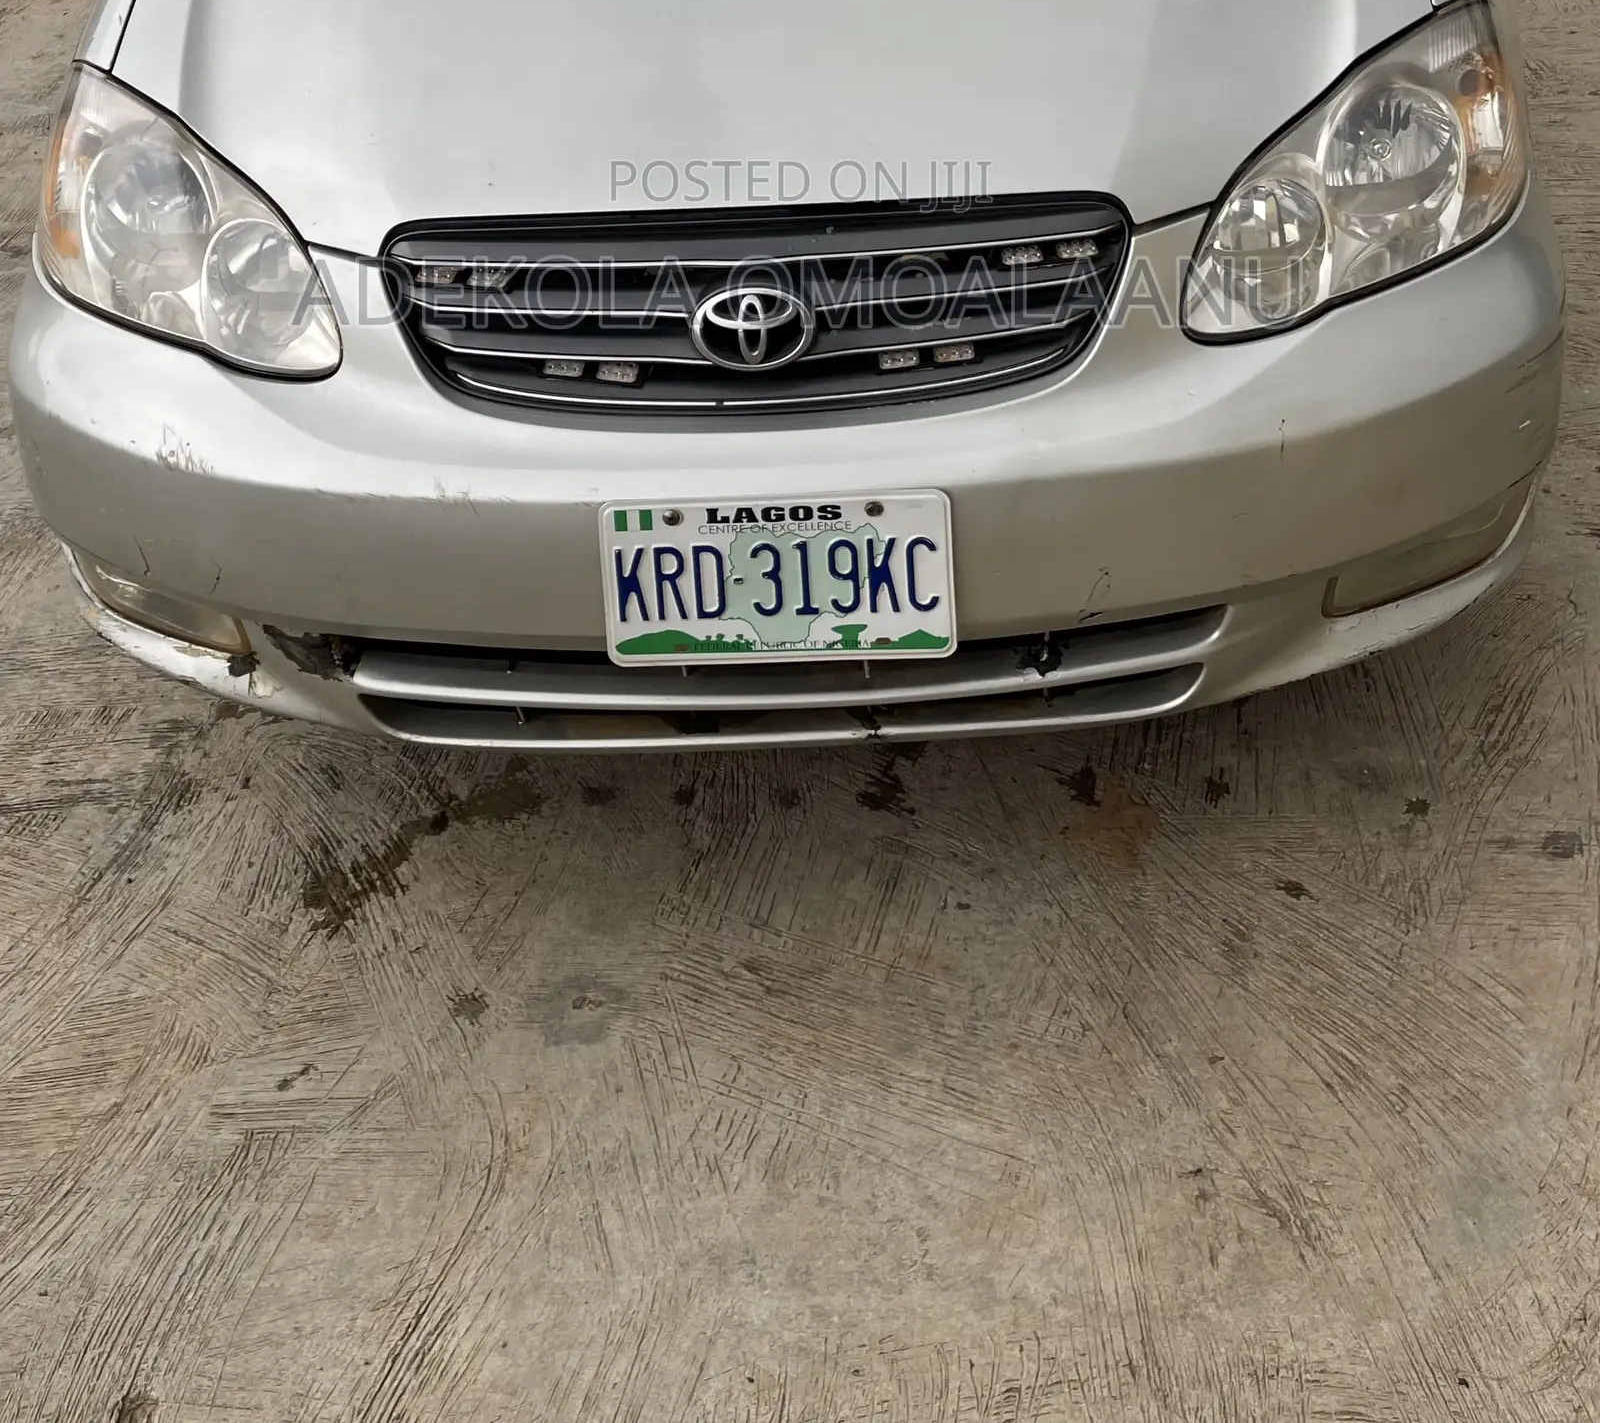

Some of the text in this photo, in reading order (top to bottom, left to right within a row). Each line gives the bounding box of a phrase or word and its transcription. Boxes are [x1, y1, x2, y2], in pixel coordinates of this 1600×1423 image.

[705, 504, 842, 524] LAGOS
[697, 520, 851, 535] CENTRE OF EXCELLENCE
[613, 535, 941, 623] KRD-319KC
